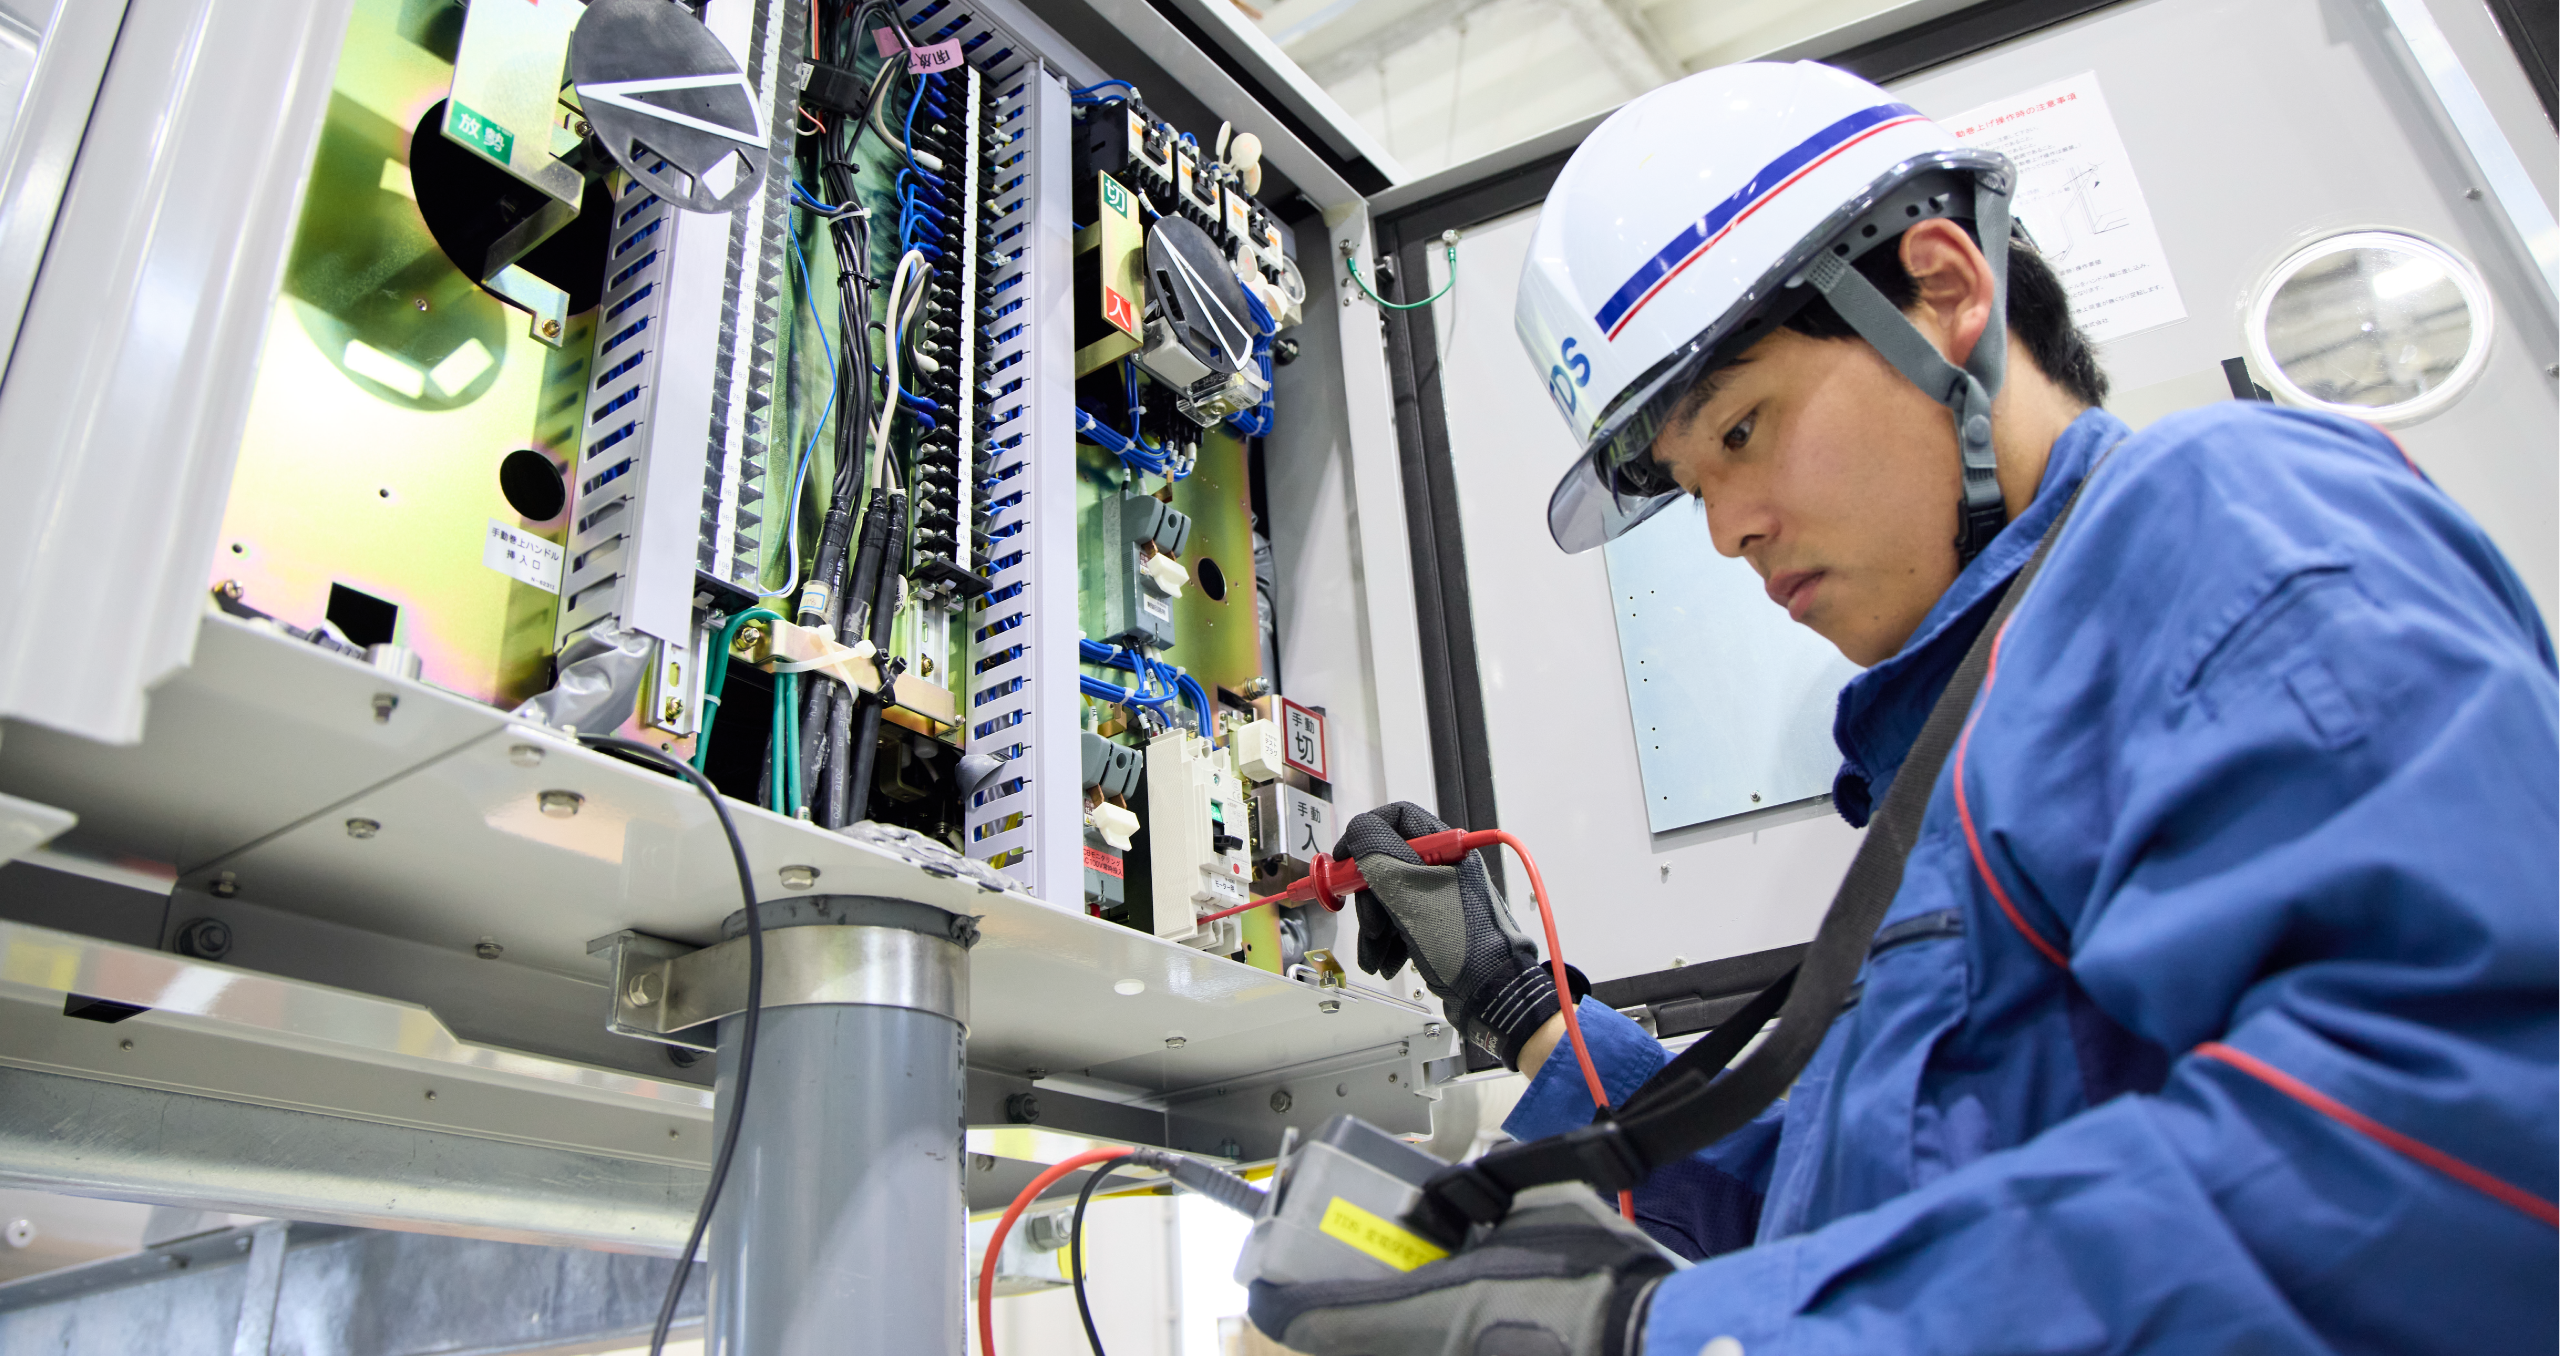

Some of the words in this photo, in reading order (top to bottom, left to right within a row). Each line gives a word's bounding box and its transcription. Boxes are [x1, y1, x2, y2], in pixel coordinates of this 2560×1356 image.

[1951, 92, 2077, 138] 動巻上げ操作時の注意事項
[458, 113, 505, 153] 放勢
[1105, 179, 1126, 212] 切
[1108, 294, 1130, 328] 入
[492, 527, 559, 561] 手動巻上ハンドル
[1292, 712, 1315, 735] 手動
[1295, 731, 1314, 765] 切
[1297, 801, 1321, 824] 手動
[1301, 823, 1321, 853] 入
